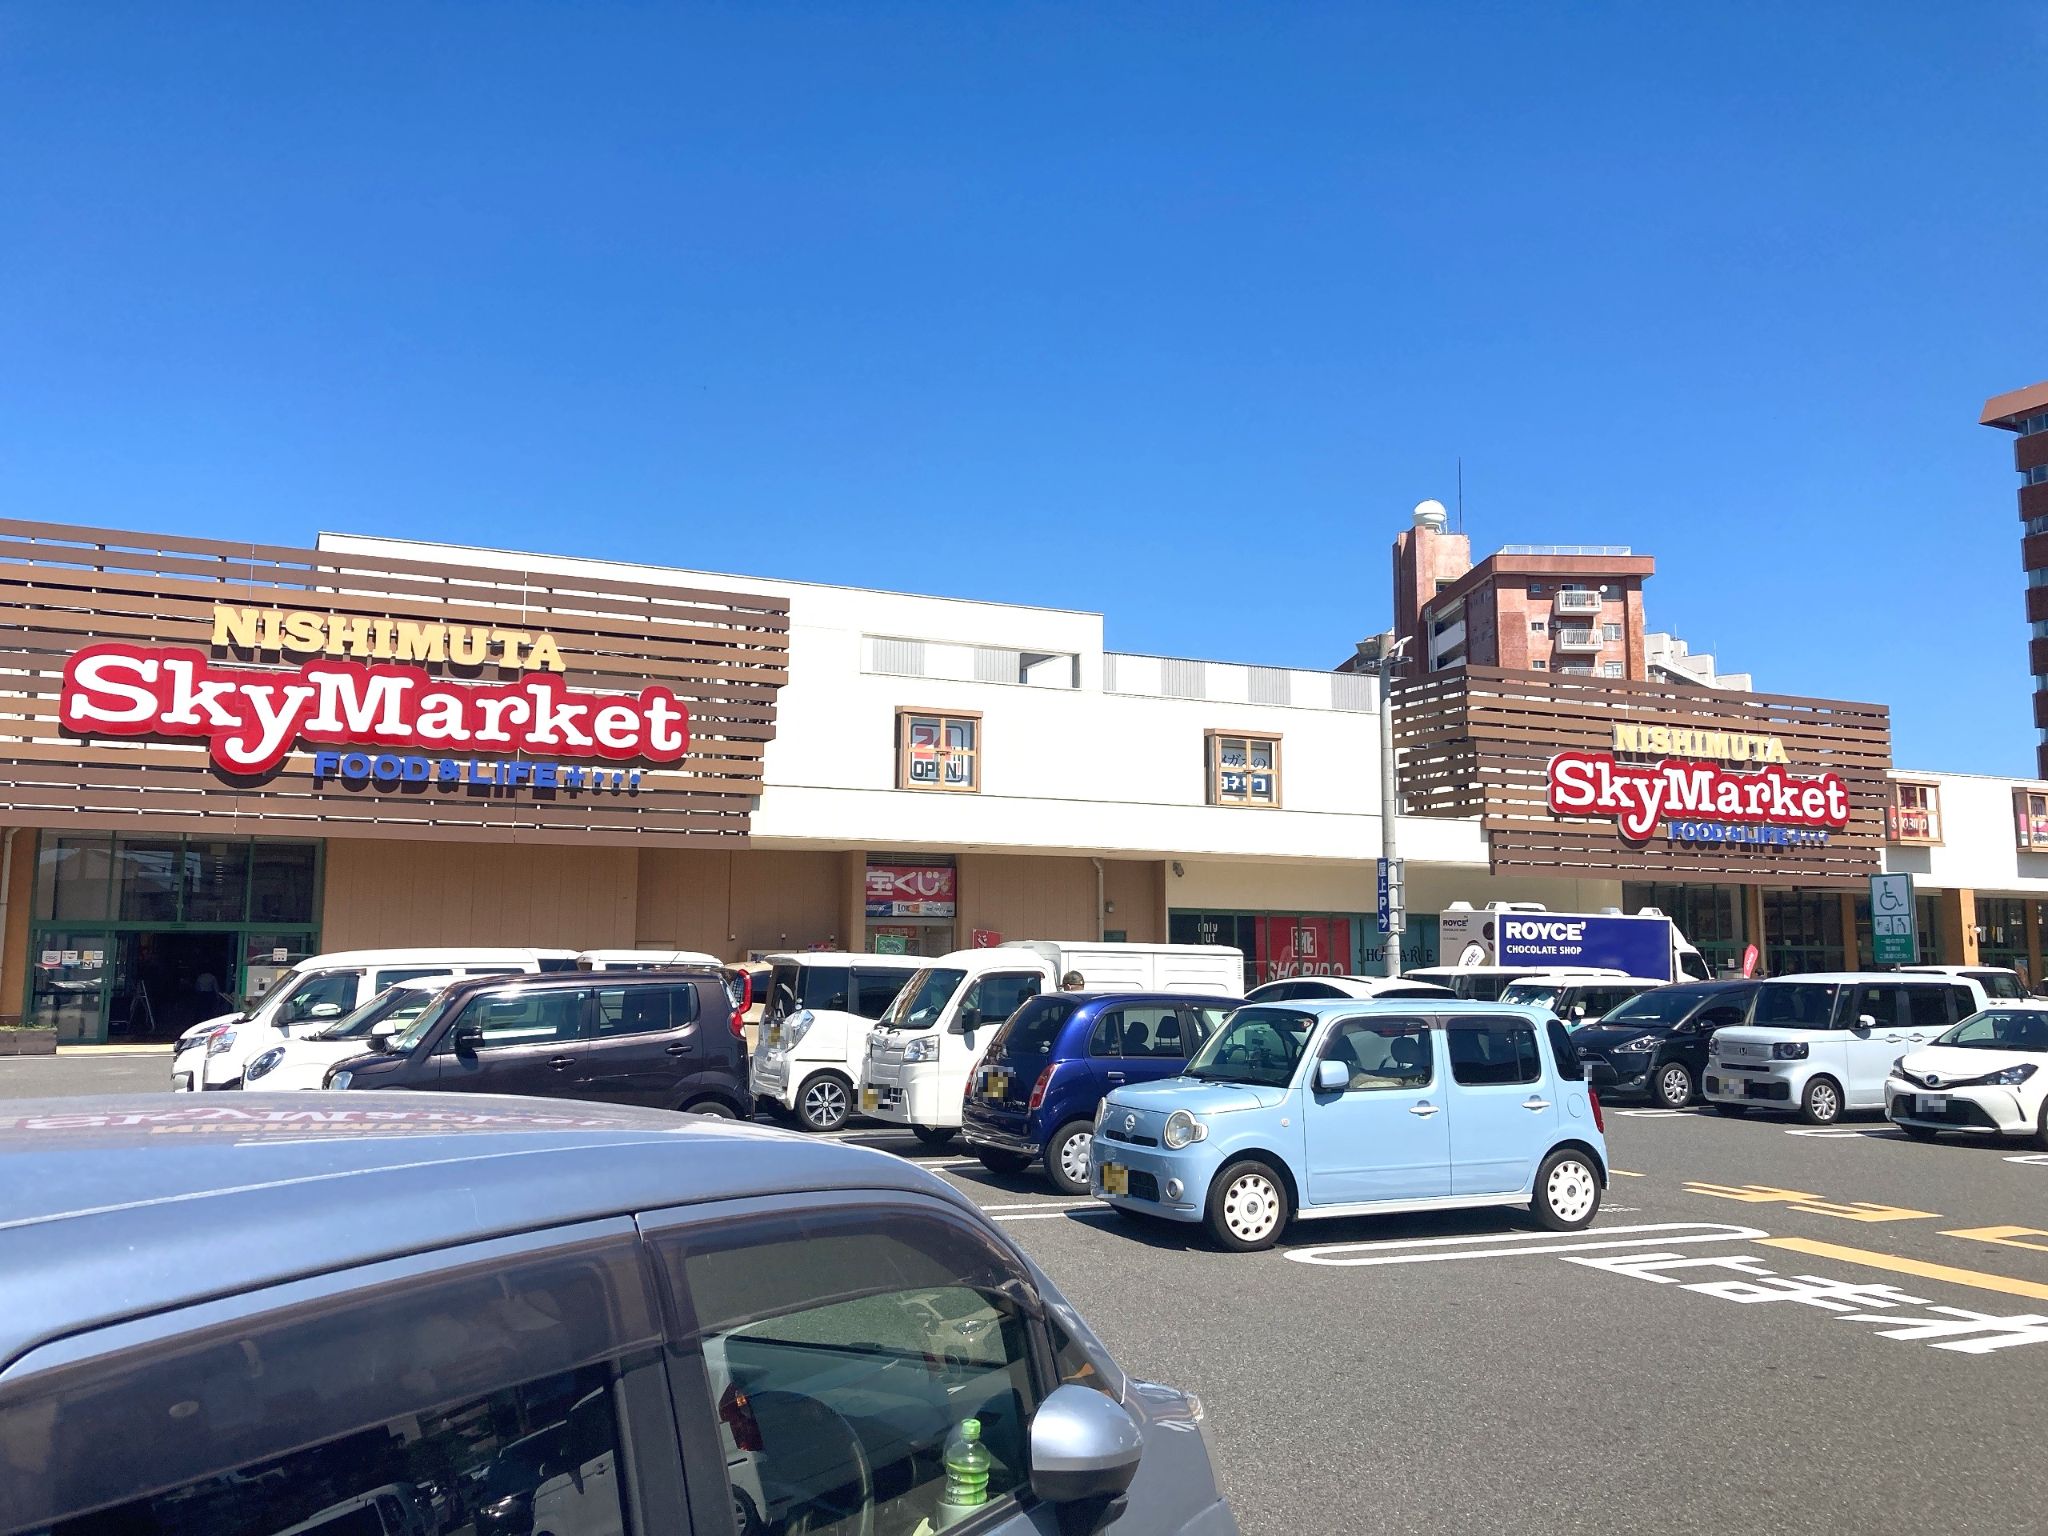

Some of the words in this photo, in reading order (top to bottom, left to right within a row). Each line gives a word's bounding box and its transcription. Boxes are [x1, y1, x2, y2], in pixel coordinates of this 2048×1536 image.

[211, 605, 566, 672] NISHIMUTA
[69, 653, 683, 764] SkyMarket
[1612, 723, 1791, 764] NISHIMUTA
[1555, 759, 1847, 833] SkyMarket
[866, 870, 941, 896] 宝くじ
[1505, 921, 1587, 942] ROYCE'
[1506, 945, 1557, 955] CHOCOLATE
[1560, 946, 1582, 955] SHOP
